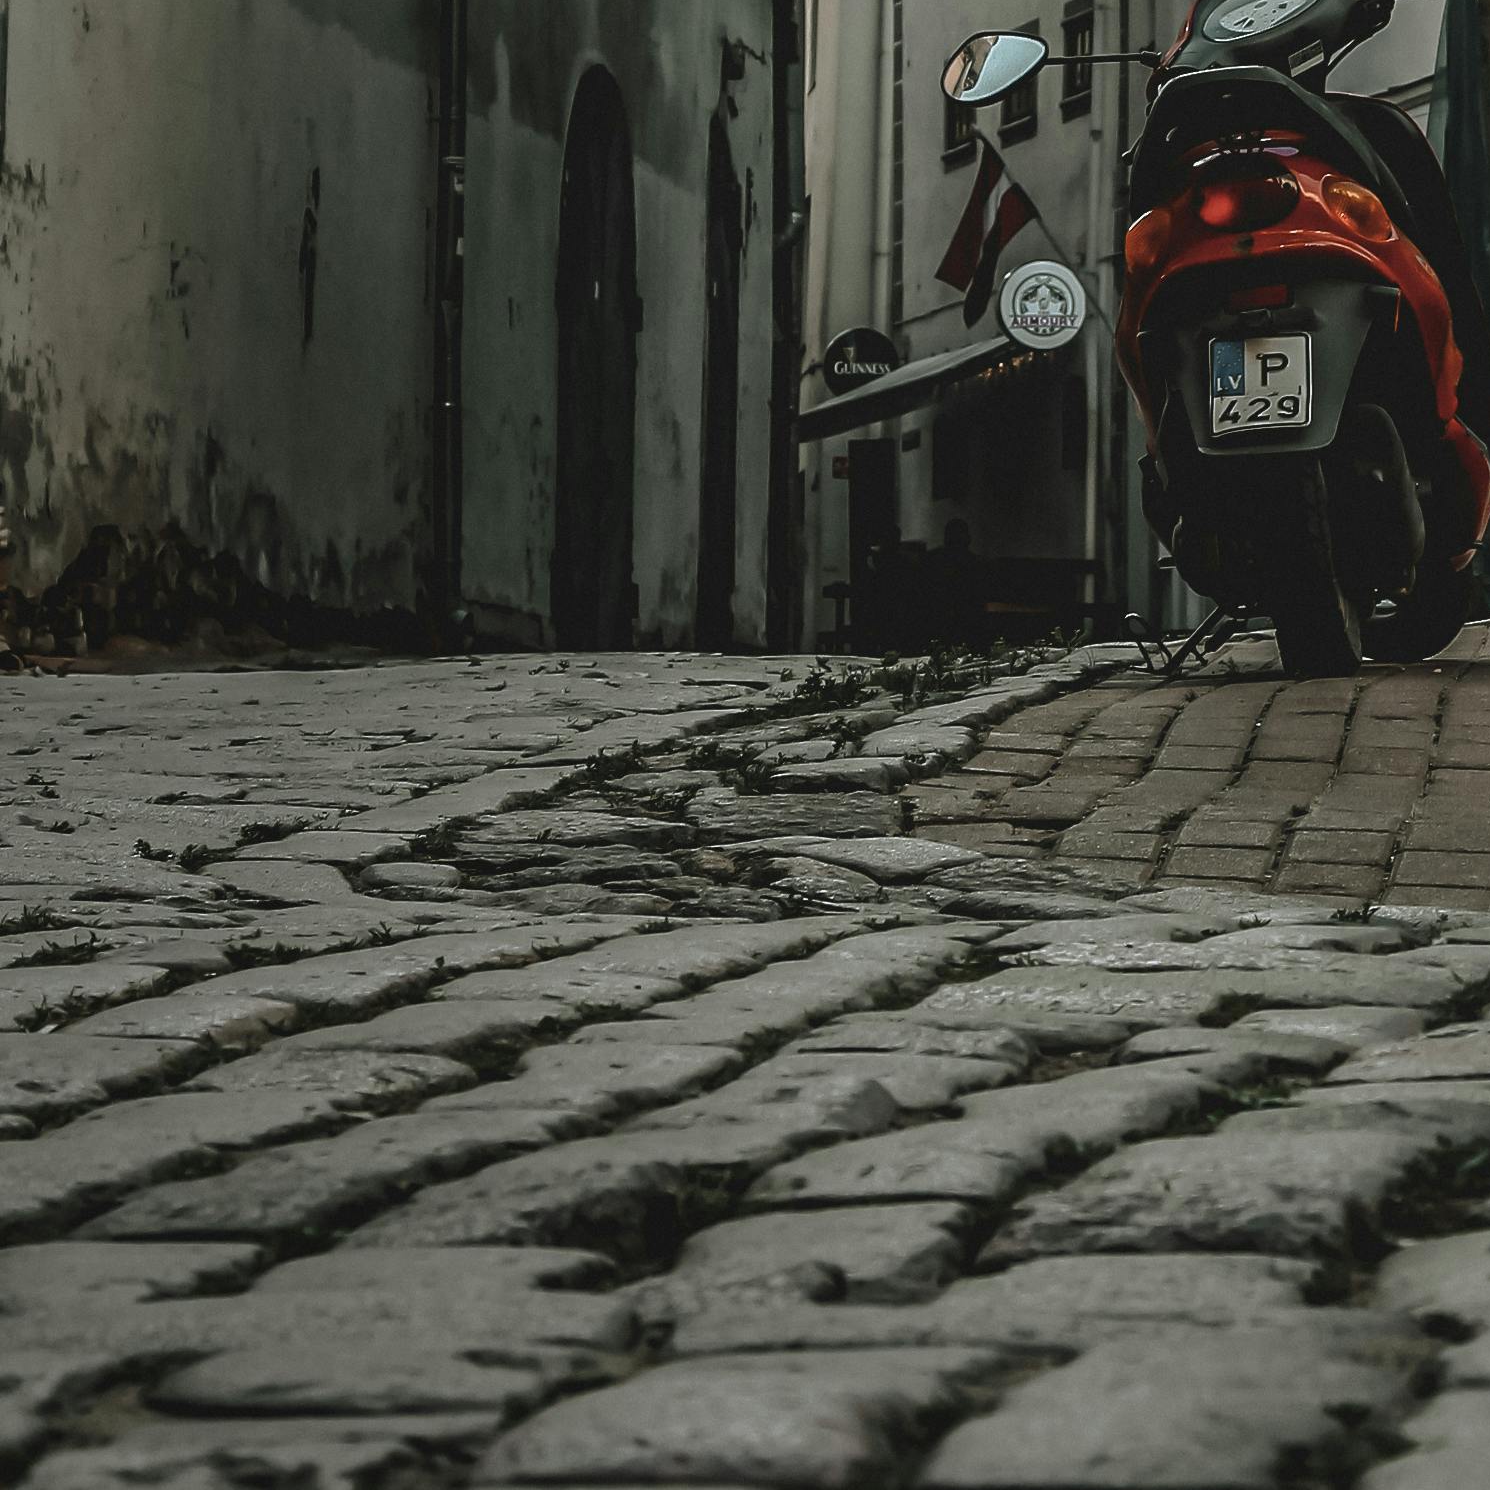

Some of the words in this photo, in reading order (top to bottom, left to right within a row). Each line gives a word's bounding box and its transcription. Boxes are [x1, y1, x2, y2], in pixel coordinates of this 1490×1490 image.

[1011, 315, 1078, 328] ARMOURY
[834, 360, 891, 376] GUINNESS
[1255, 351, 1290, 387] P
[1218, 394, 1301, 425] 429
